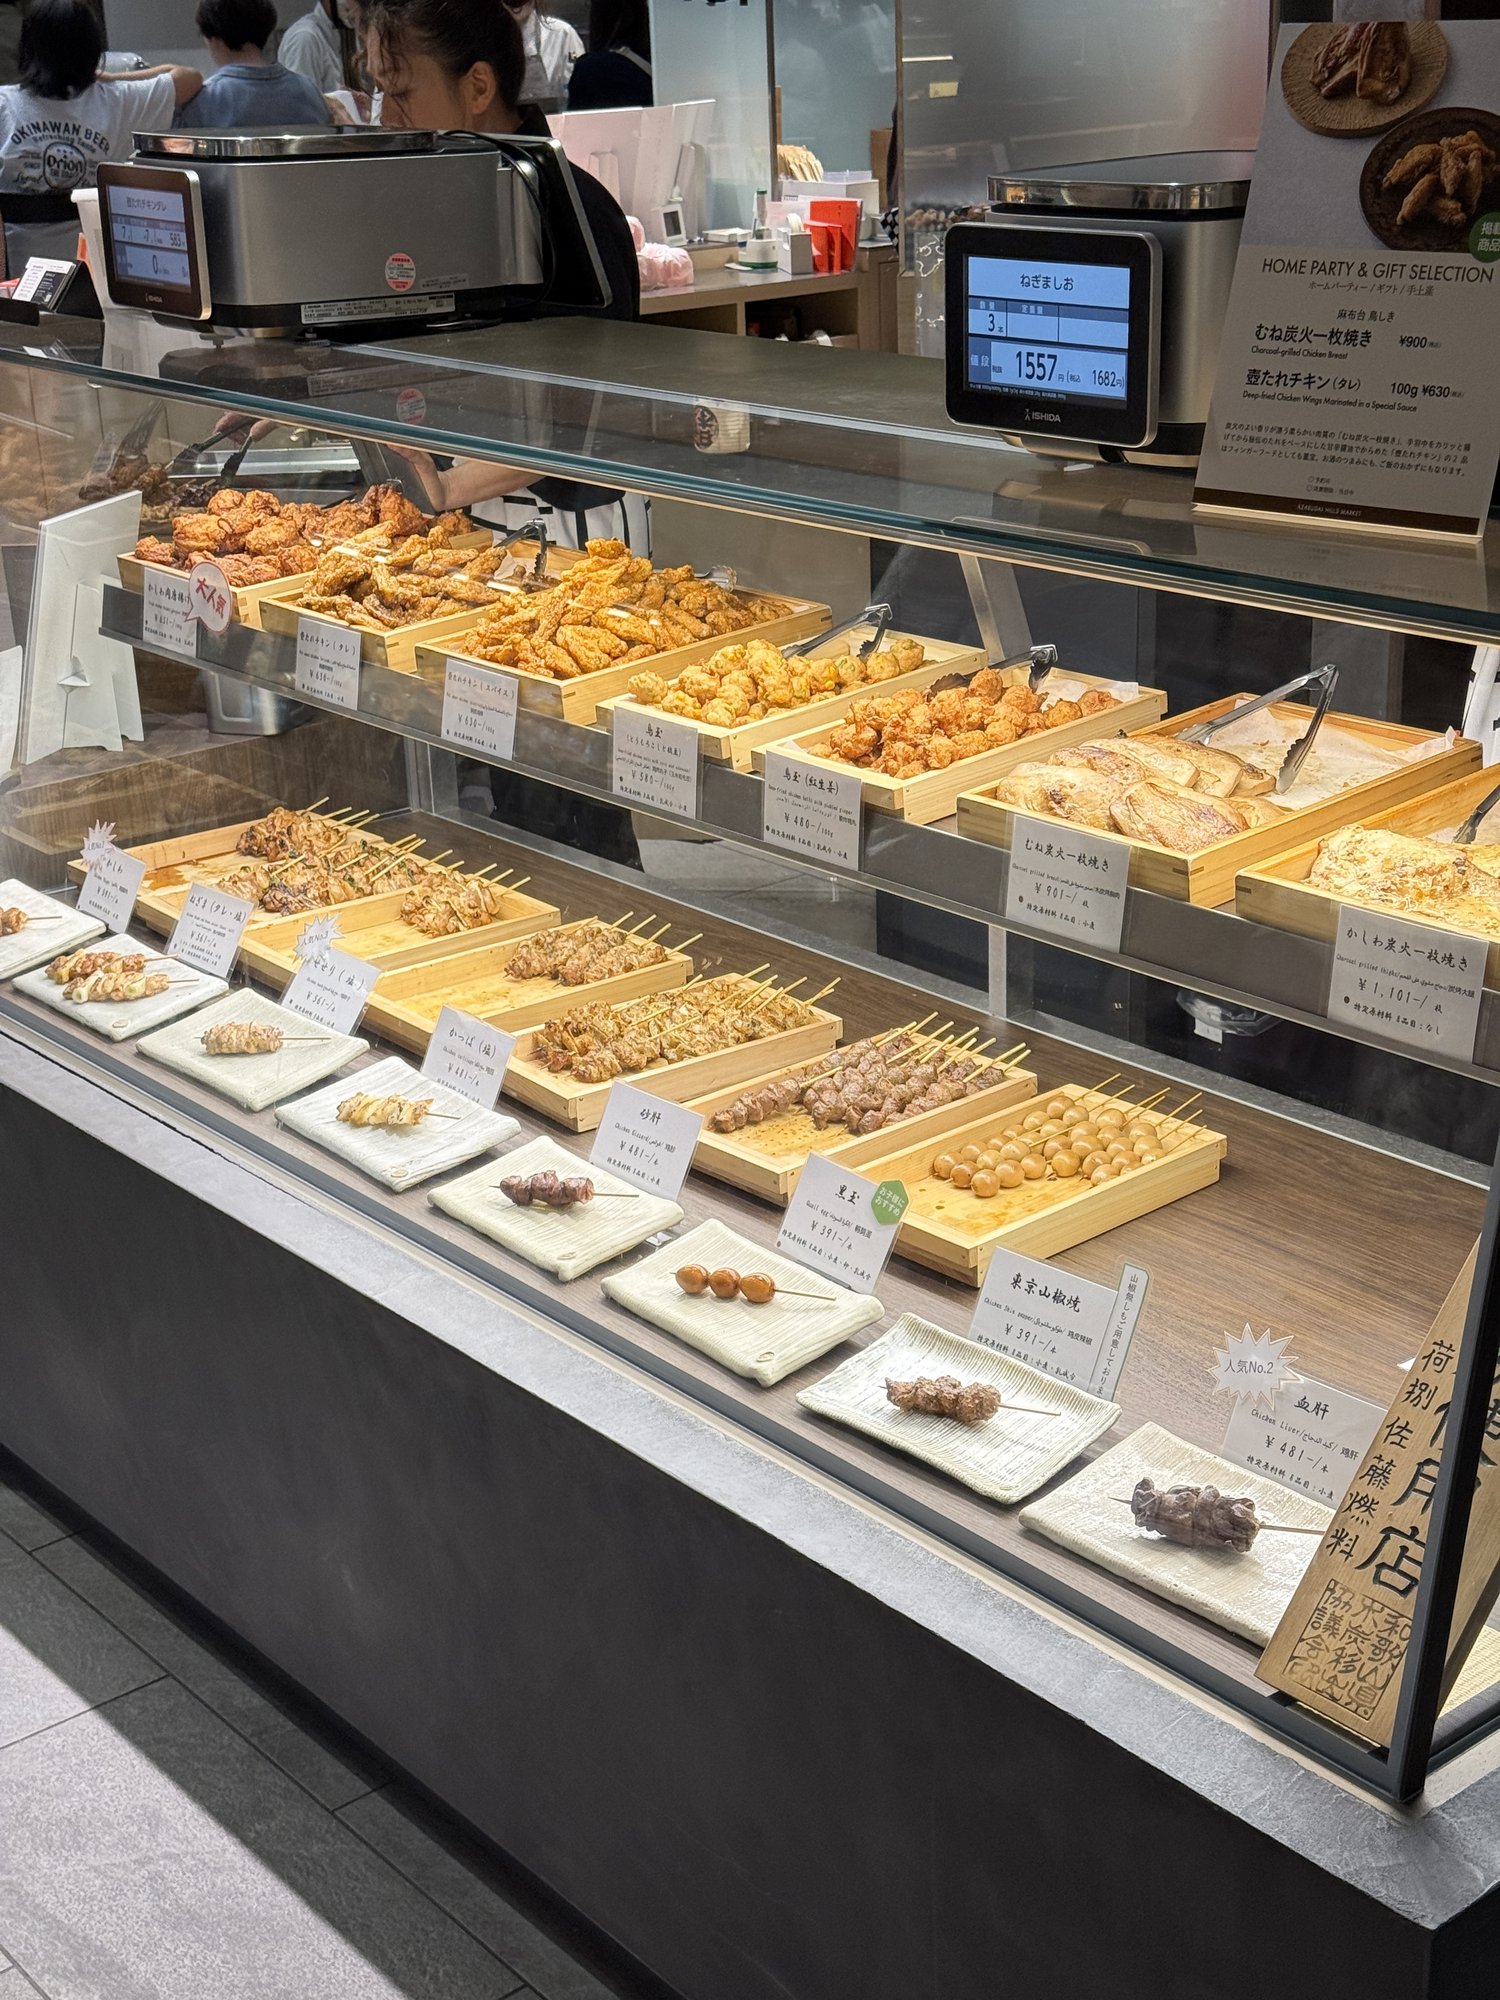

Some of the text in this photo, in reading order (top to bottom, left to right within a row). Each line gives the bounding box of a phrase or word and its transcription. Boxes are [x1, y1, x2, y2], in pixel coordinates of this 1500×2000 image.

[11, 121, 110, 156] OKINAWAN BEER
[47, 155, 83, 172] Orion
[1262, 258, 1494, 283] HOME PARTY & GIFT SELECTION
[1020, 273, 1074, 291] ねぎましお
[1377, 284, 1398, 293] ギフト
[1407, 285, 1434, 297] 手土産
[988, 313, 995, 332] 3
[1337, 309, 1395, 323] 麻布台 鳥しき
[1255, 323, 1427, 349] むね炭火一枚焼き ¥900
[970, 354, 990, 367] 値段
[1251, 345, 1348, 359] Charcoal-grilled Chicken Breast
[1015, 350, 1058, 381] 1557
[1391, 382, 1419, 398] 100g
[1421, 384, 1450, 398] ¥630
[1243, 390, 1276, 400] Deep-fried
[1277, 393, 1300, 402] Chicken
[1302, 395, 1323, 406] Wings
[1324, 398, 1357, 407] Marinated
[1371, 400, 1396, 411] Special
[1397, 402, 1417, 412] Sauce
[1032, 411, 1061, 423] ISHIDA
[195, 577, 227, 619] 大人気
[1025, 838, 1109, 873] むね炭火一枚焼き
[1346, 927, 1468, 972] かしわ炭火一枚焼き
[640, 1108, 662, 1126] 砂肝
[875, 1195, 900, 1216] おすすめ
[880, 1187, 905, 1208] お子様に
[1011, 1272, 1081, 1313] 東京山椒焼
[1224, 1359, 1274, 1375] 人気No.2
[1251, 1408, 1277, 1426] Chicken
[1294, 1395, 1330, 1420] 血肝
[1325, 1339, 1456, 1563] 荷捌佐藤燃料
